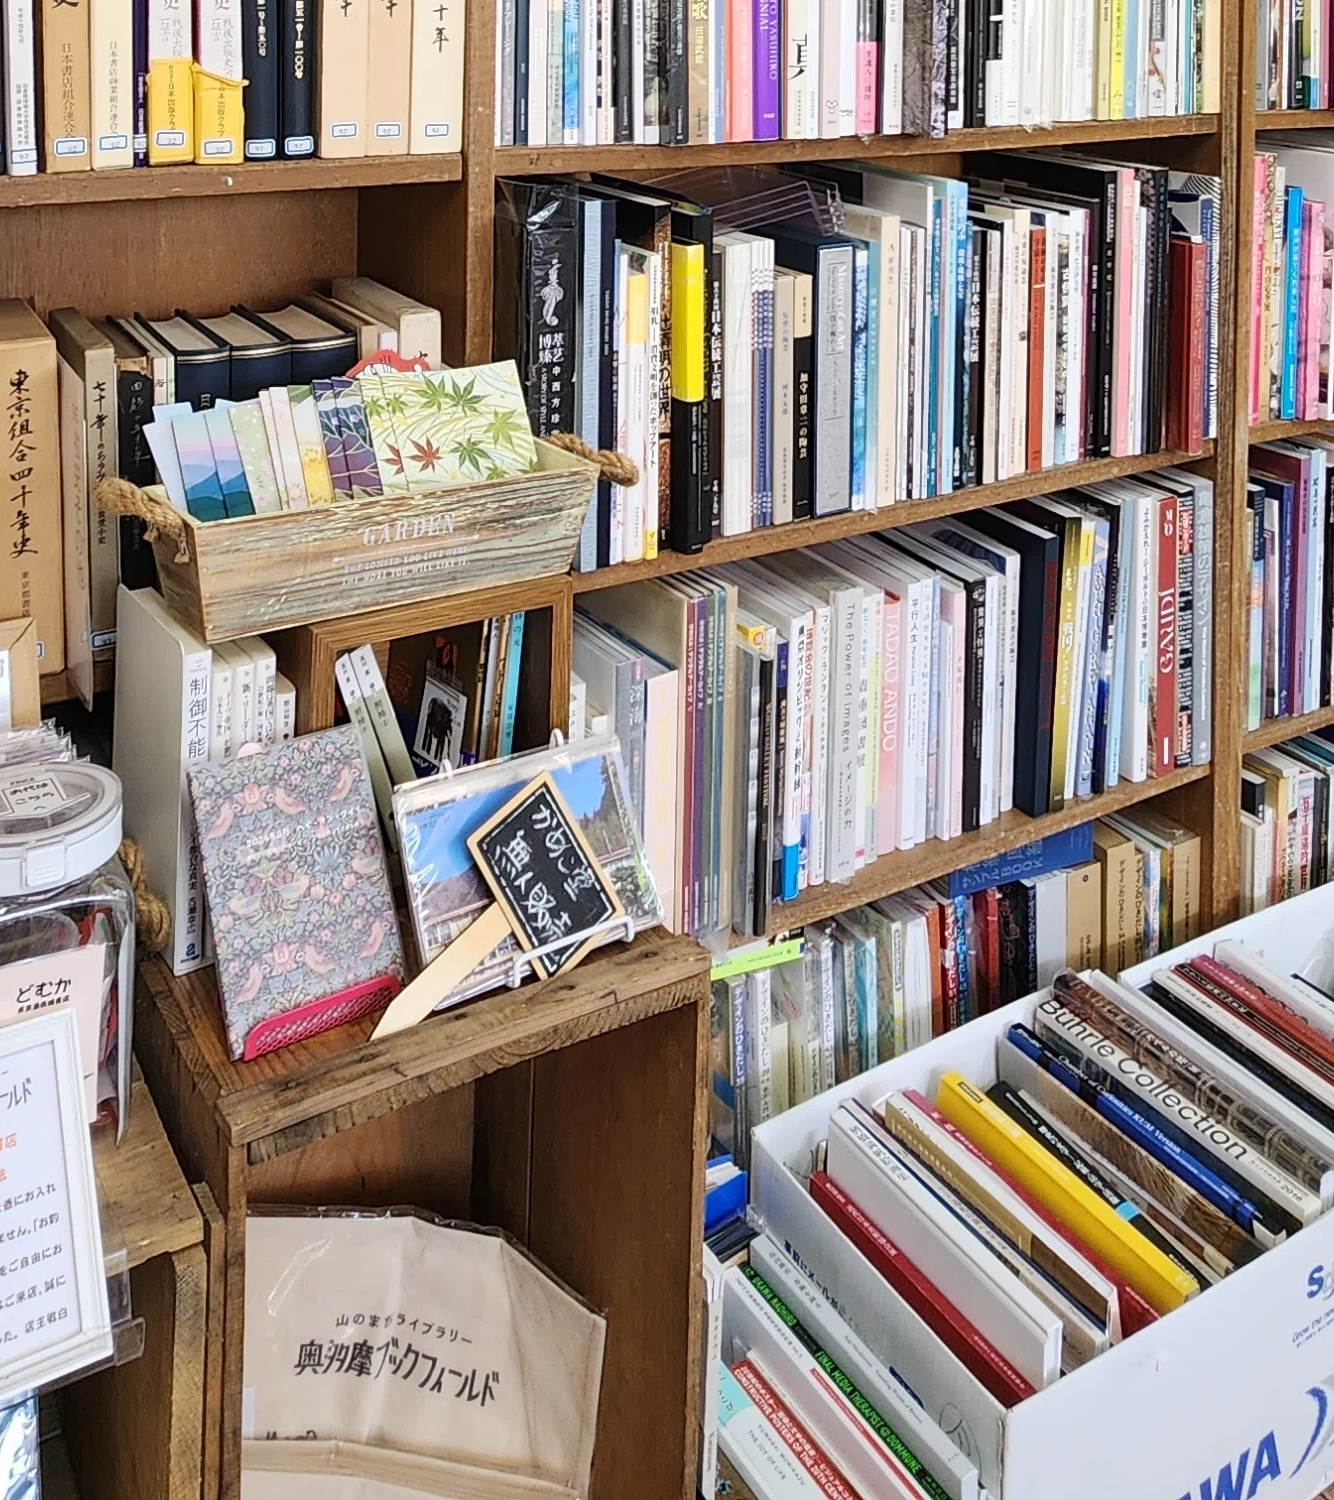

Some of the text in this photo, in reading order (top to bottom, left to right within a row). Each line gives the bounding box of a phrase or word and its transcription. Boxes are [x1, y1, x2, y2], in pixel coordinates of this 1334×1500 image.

[7, 368, 40, 559] 東京組合四十年史
[361, 512, 456, 547] GARDEN
[186, 672, 210, 760] 制御不能
[882, 605, 900, 752] TADAO ANDO
[15, 977, 73, 1004] どむか
[1116, 1056, 1249, 1162] Collection
[293, 1336, 501, 1408] 奥多摩ブックフィールド
